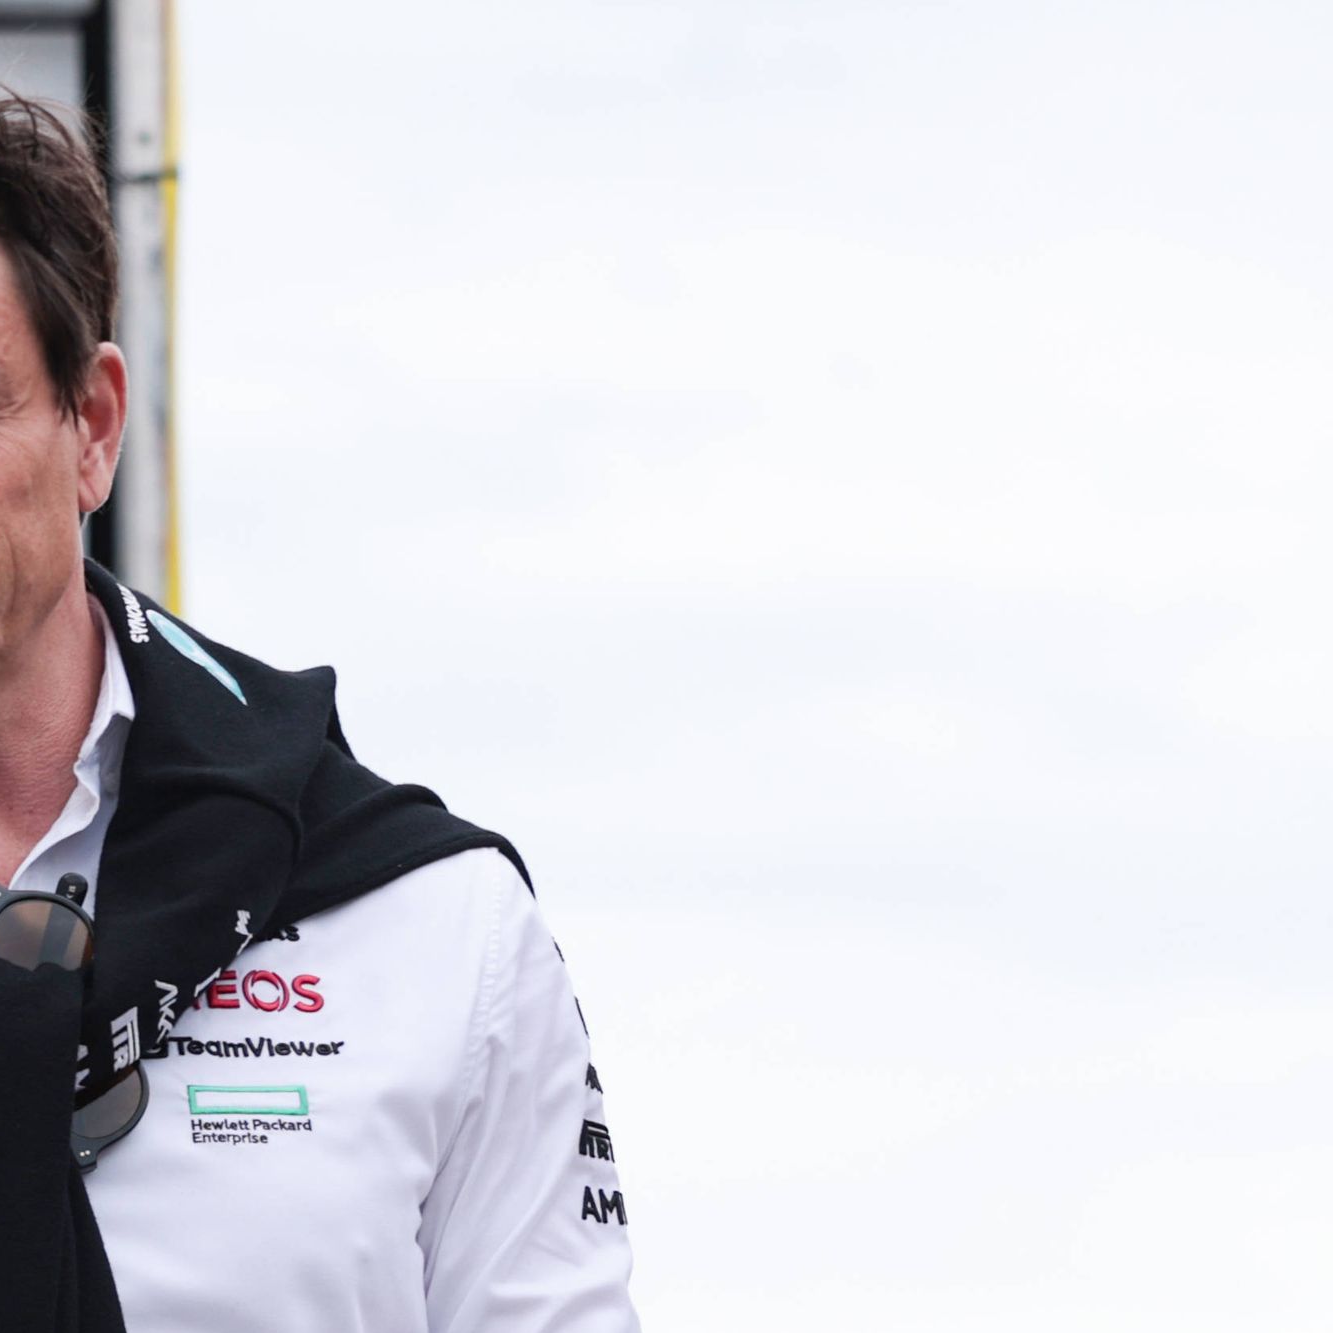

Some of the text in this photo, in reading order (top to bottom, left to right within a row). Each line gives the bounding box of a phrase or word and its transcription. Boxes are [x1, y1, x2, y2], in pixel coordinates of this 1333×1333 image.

[167, 1036, 345, 1058] TeamViewer
[191, 1118, 312, 1132] Hewlett Packard
[192, 1132, 269, 1145] Enterprise
